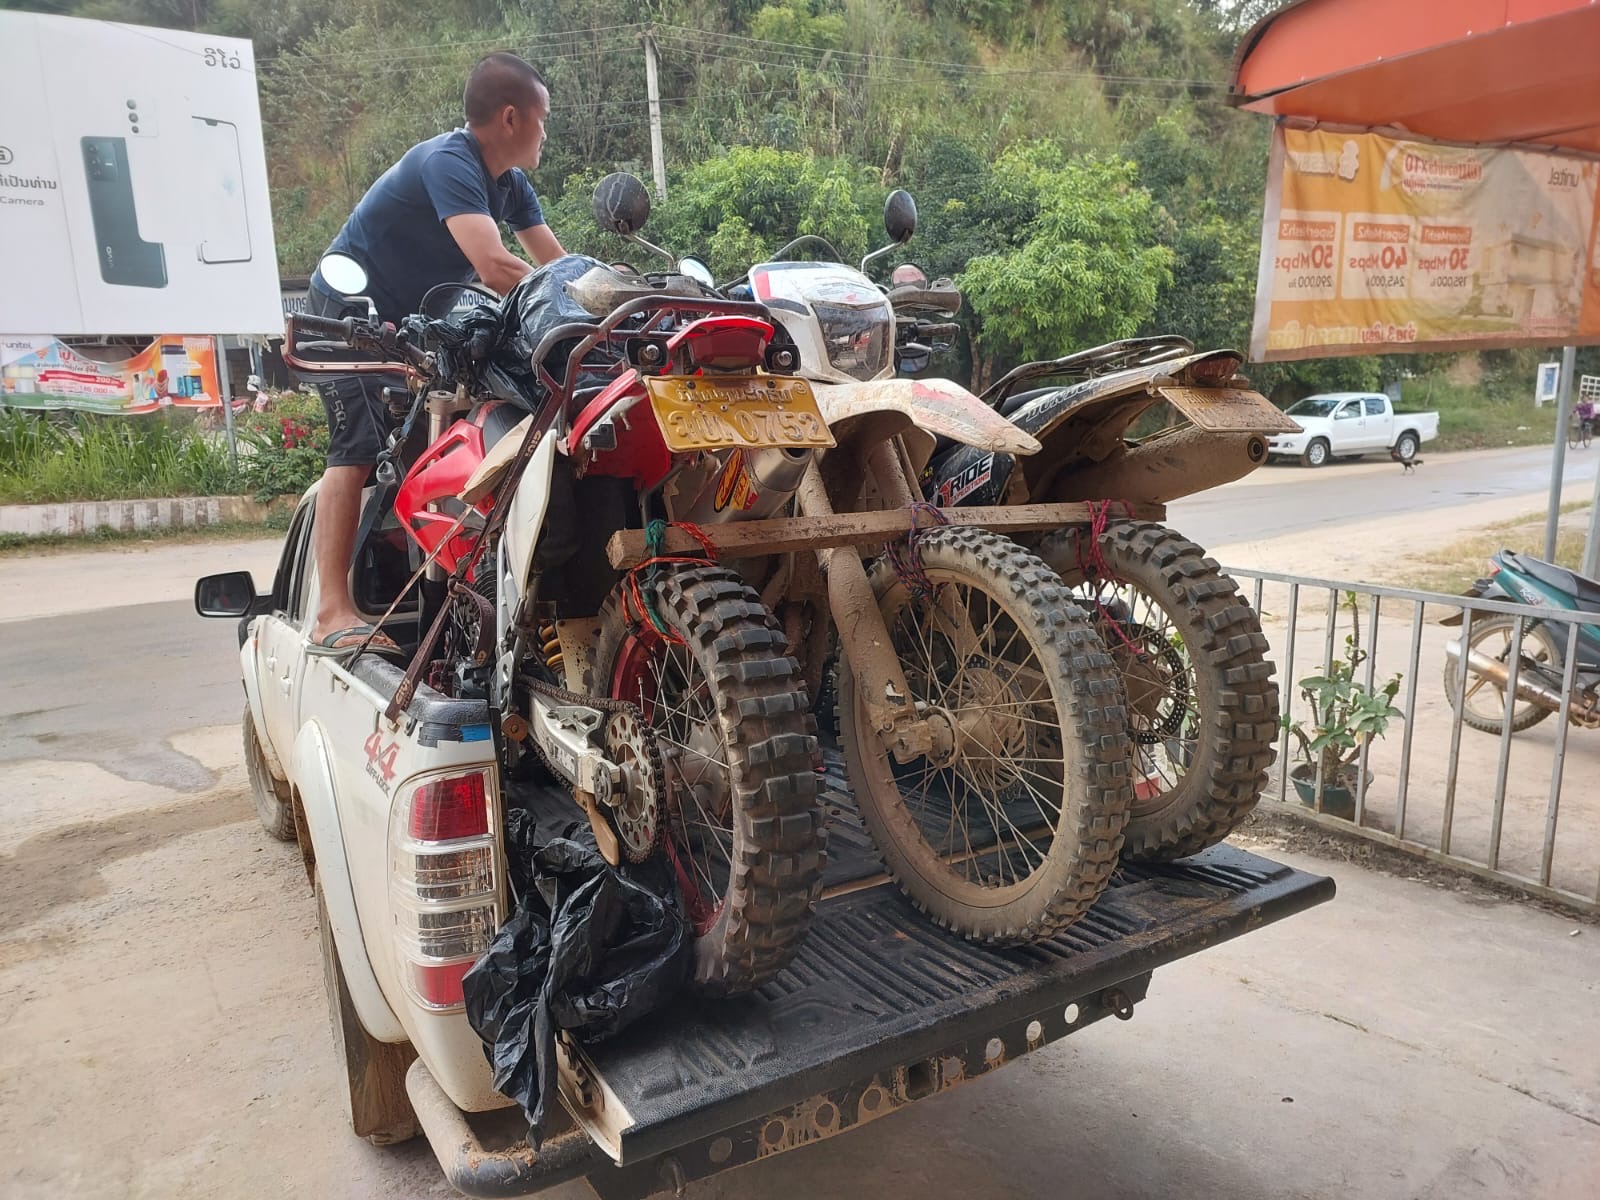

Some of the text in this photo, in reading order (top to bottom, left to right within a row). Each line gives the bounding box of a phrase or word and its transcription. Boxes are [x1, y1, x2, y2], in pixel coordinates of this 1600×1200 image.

[0, 196, 45, 206] Camera
[735, 410, 827, 442] 0752
[950, 454, 993, 498] RIDE
